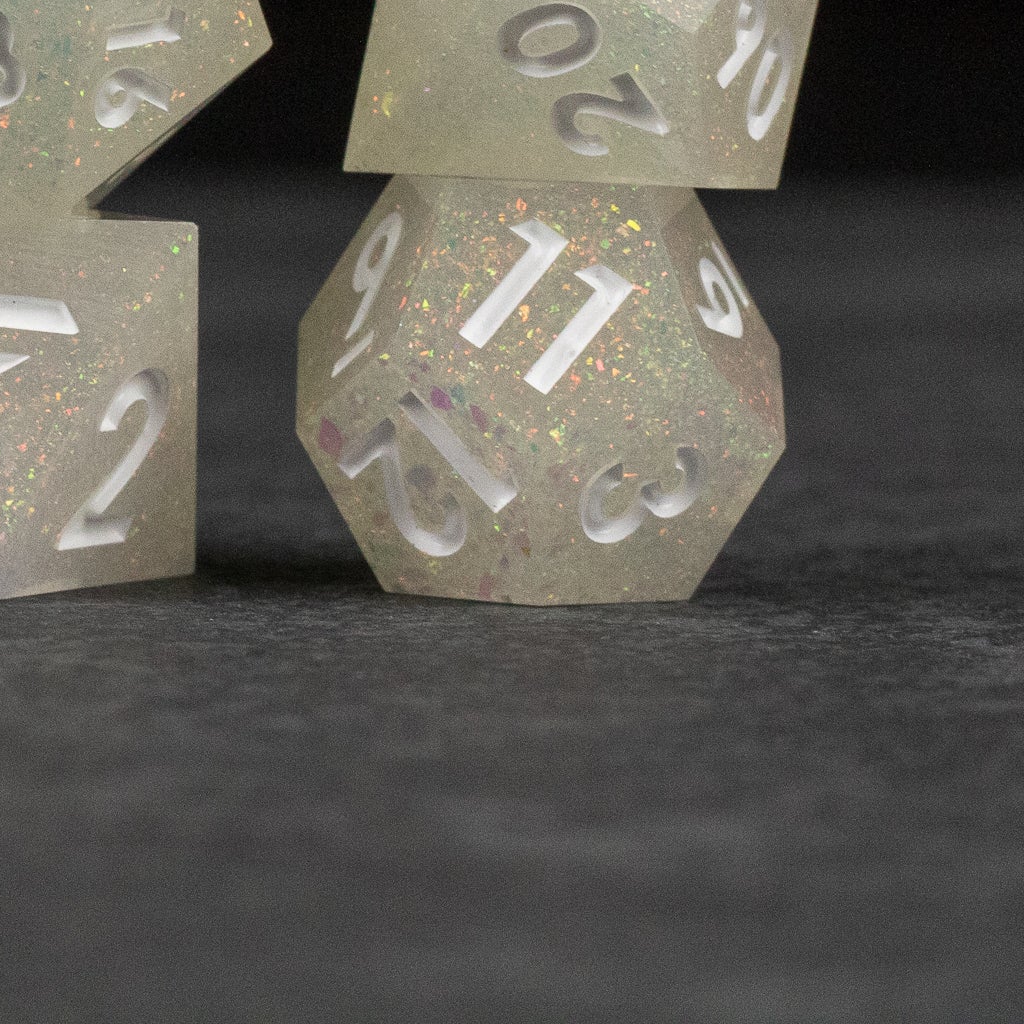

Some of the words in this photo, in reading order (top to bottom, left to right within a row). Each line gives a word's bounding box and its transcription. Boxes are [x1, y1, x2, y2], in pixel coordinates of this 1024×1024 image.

[458, 218, 633, 395] 11
[57, 368, 171, 552] 2
[338, 390, 518, 558] 12
[580, 446, 707, 544] 3
